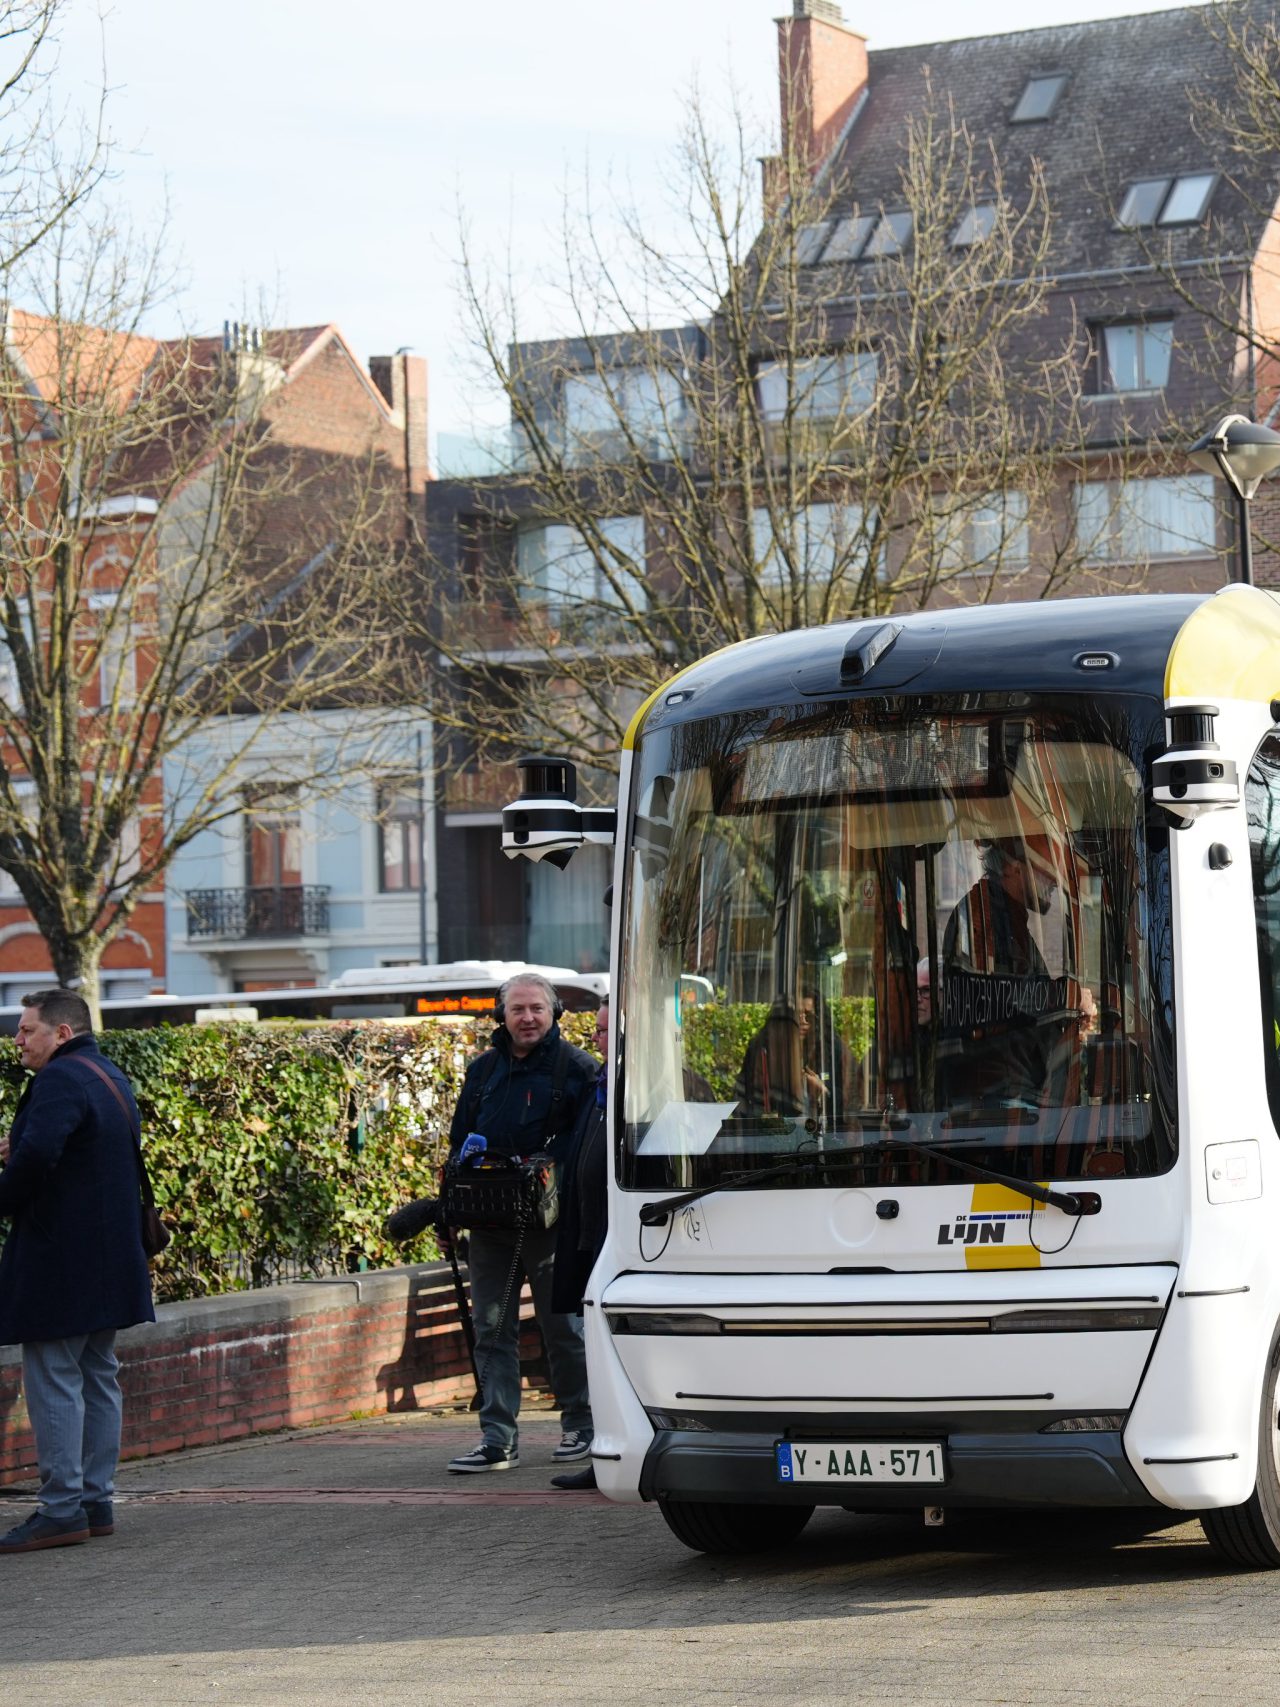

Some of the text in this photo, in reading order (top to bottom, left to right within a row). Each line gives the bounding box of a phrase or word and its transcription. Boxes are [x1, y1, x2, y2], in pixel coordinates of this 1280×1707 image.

[938, 1222, 1006, 1245] LIJN
[781, 1465, 791, 1477] B
[794, 1449, 936, 1476] Y-AAA-571
